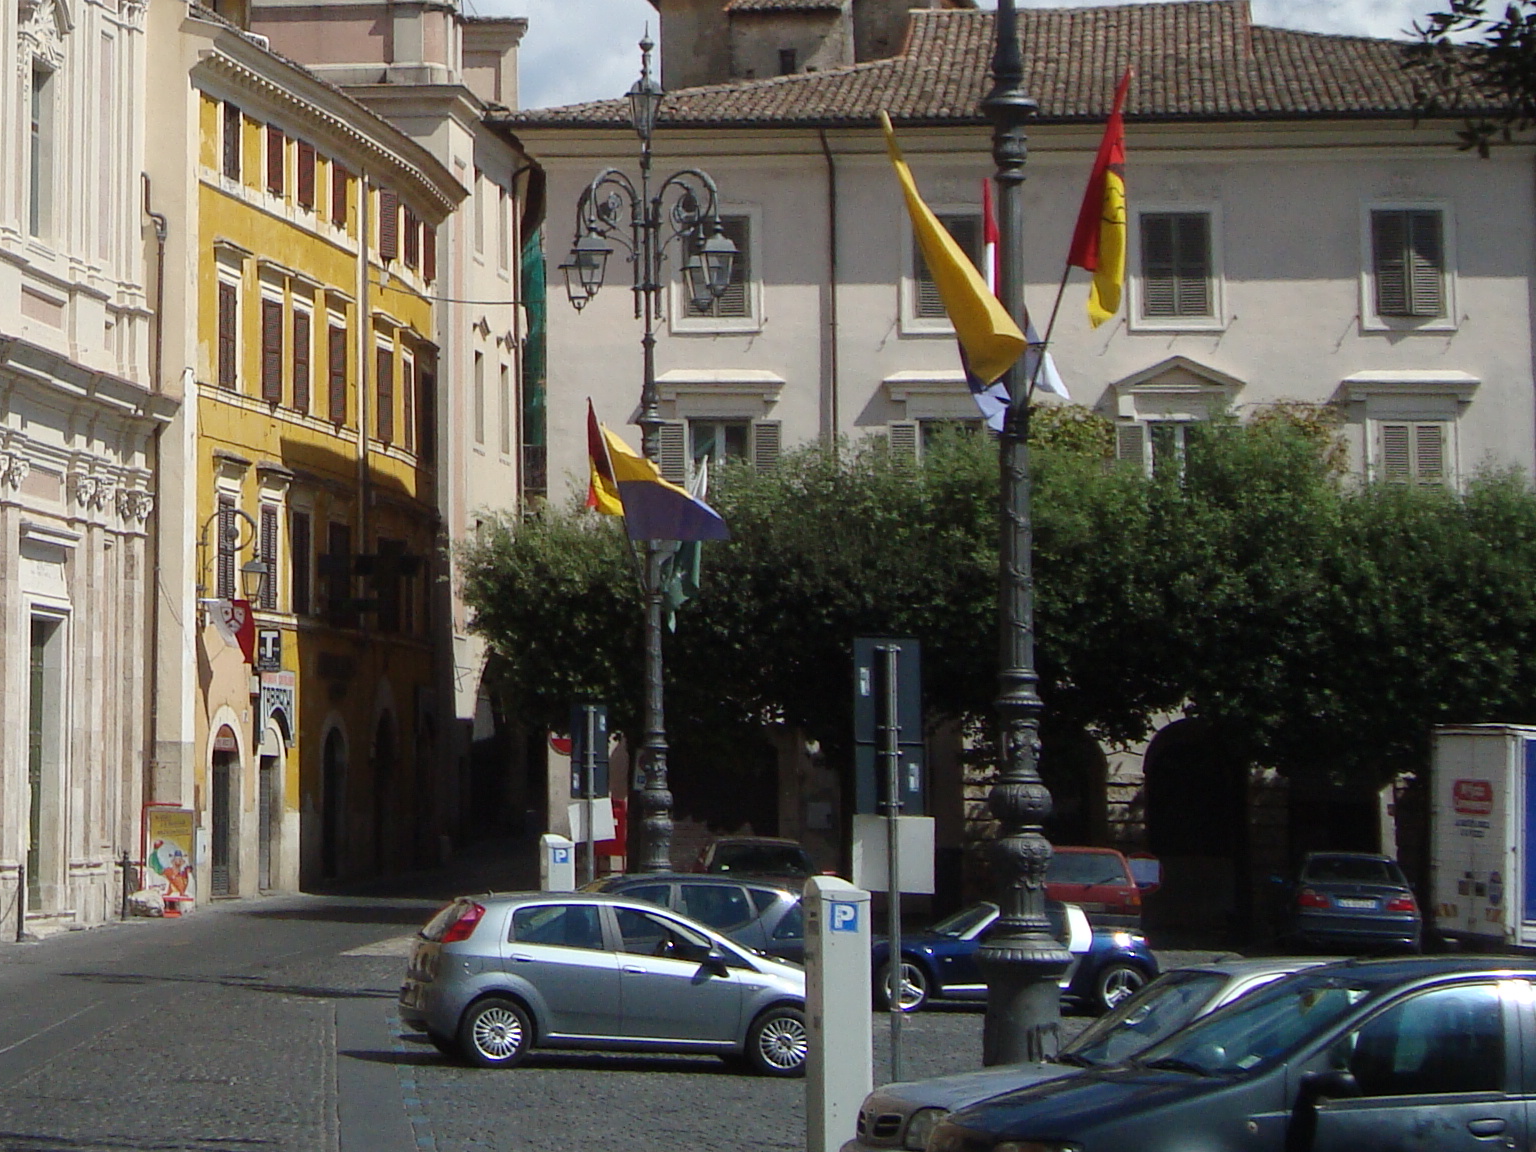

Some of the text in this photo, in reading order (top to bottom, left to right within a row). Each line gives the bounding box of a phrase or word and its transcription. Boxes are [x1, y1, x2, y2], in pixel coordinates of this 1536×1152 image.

[261, 631, 279, 658] T
[555, 849, 567, 863] P
[835, 904, 854, 929] P
